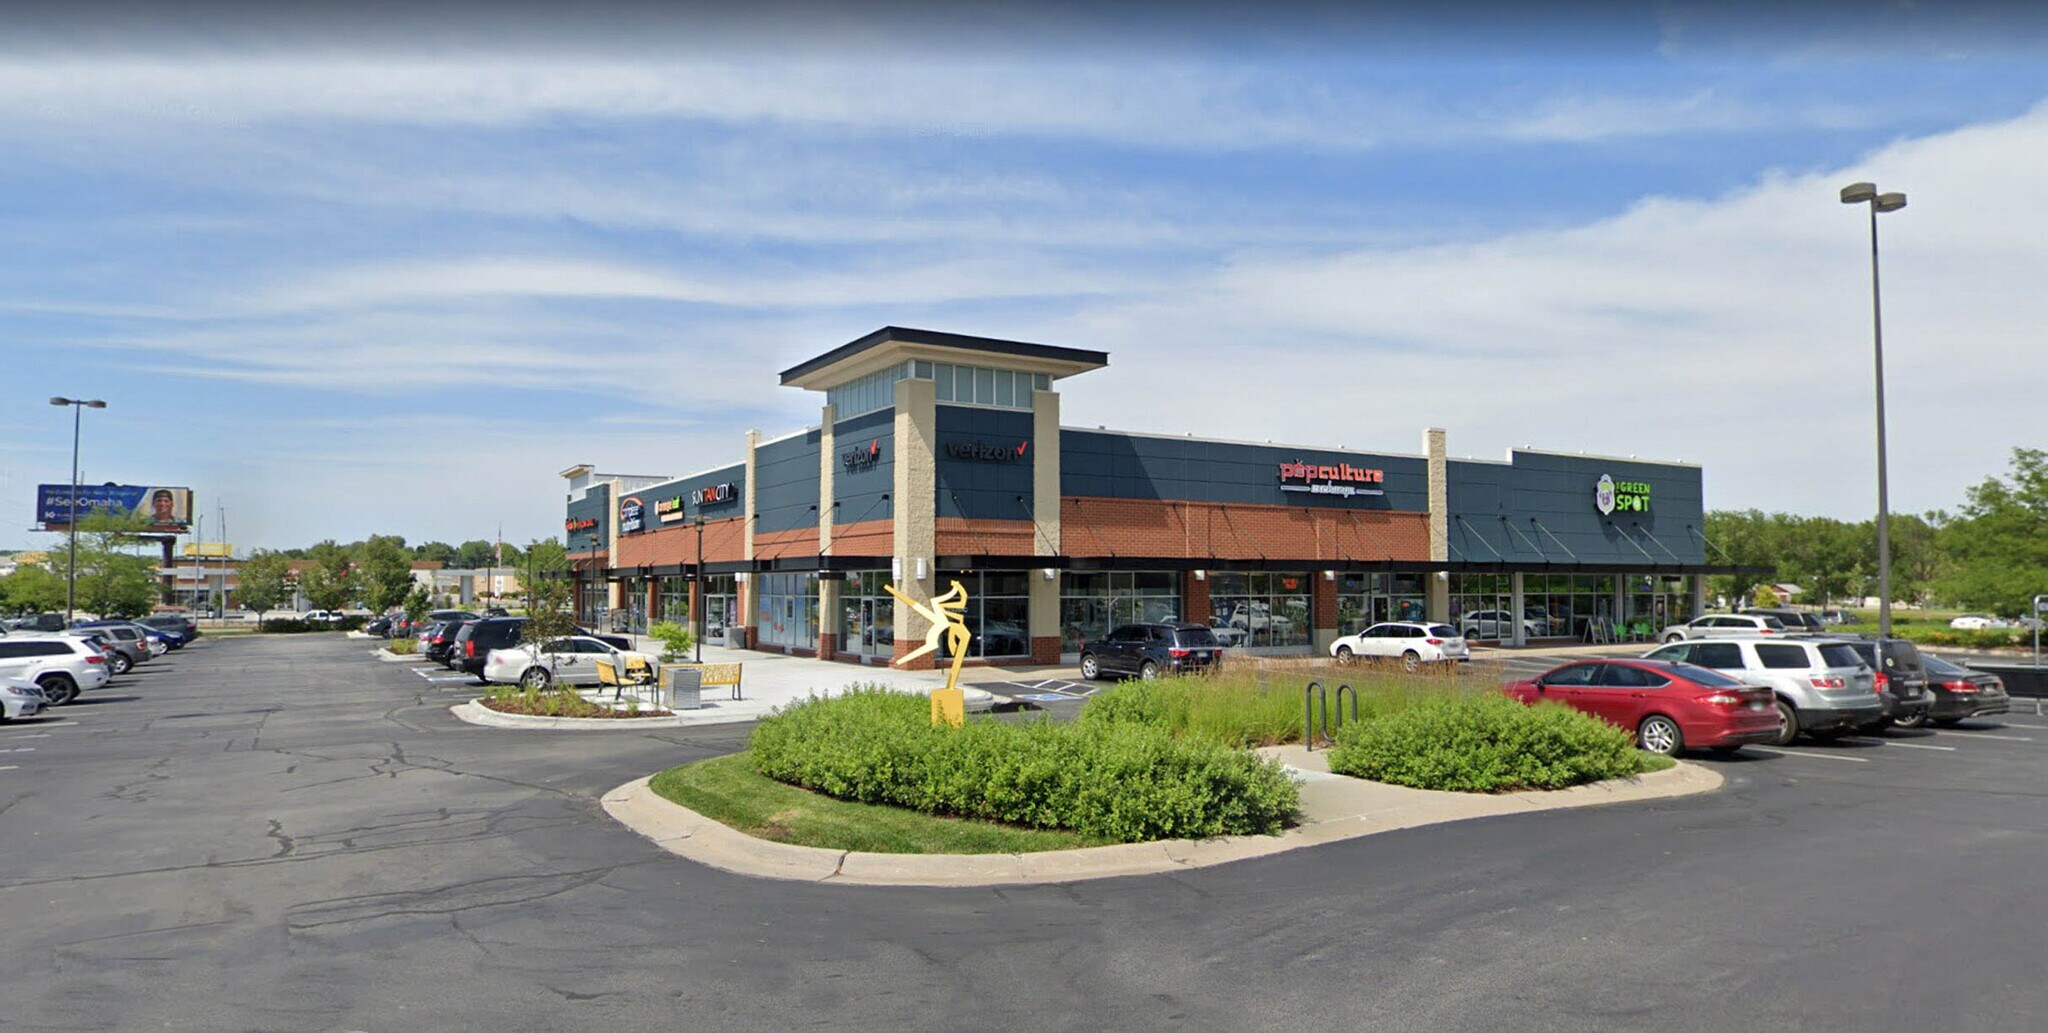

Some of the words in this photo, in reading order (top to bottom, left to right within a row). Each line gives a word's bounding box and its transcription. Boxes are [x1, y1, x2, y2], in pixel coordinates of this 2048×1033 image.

[842, 446, 873, 467] verizon
[945, 440, 1018, 461] verizon
[1620, 481, 1651, 494] GREEN
[1616, 494, 1650, 512] SPOT
